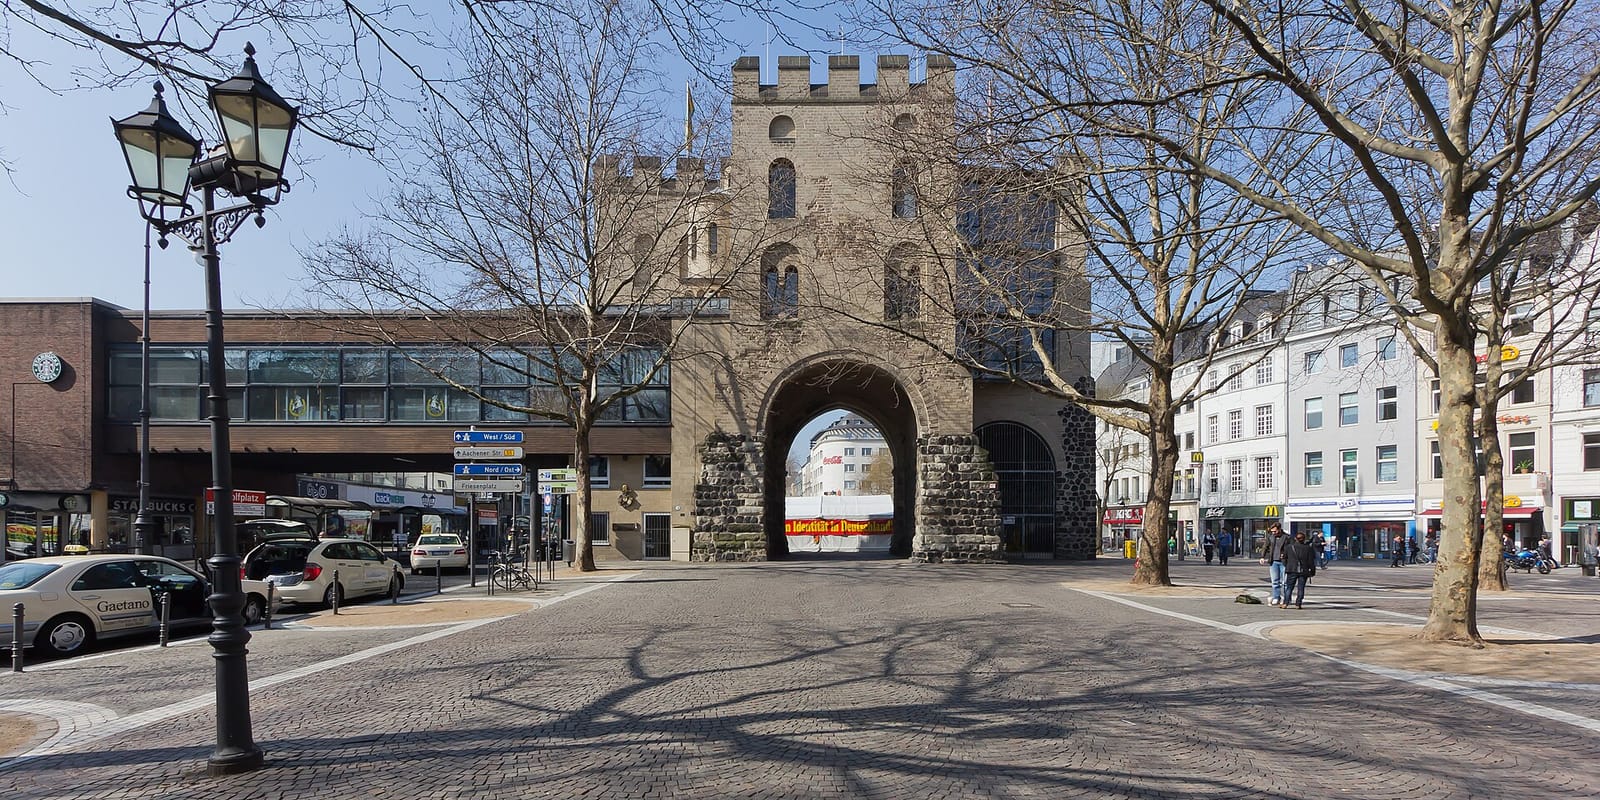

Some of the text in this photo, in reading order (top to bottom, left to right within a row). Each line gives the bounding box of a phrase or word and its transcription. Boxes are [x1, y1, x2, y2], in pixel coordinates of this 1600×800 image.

[232, 492, 259, 503] olfplatz
[113, 500, 186, 512] STABUCKS
[1116, 508, 1132, 518] KFC
[793, 520, 829, 532] Identität
[830, 521, 839, 532] in
[97, 600, 150, 613] Gaetano
